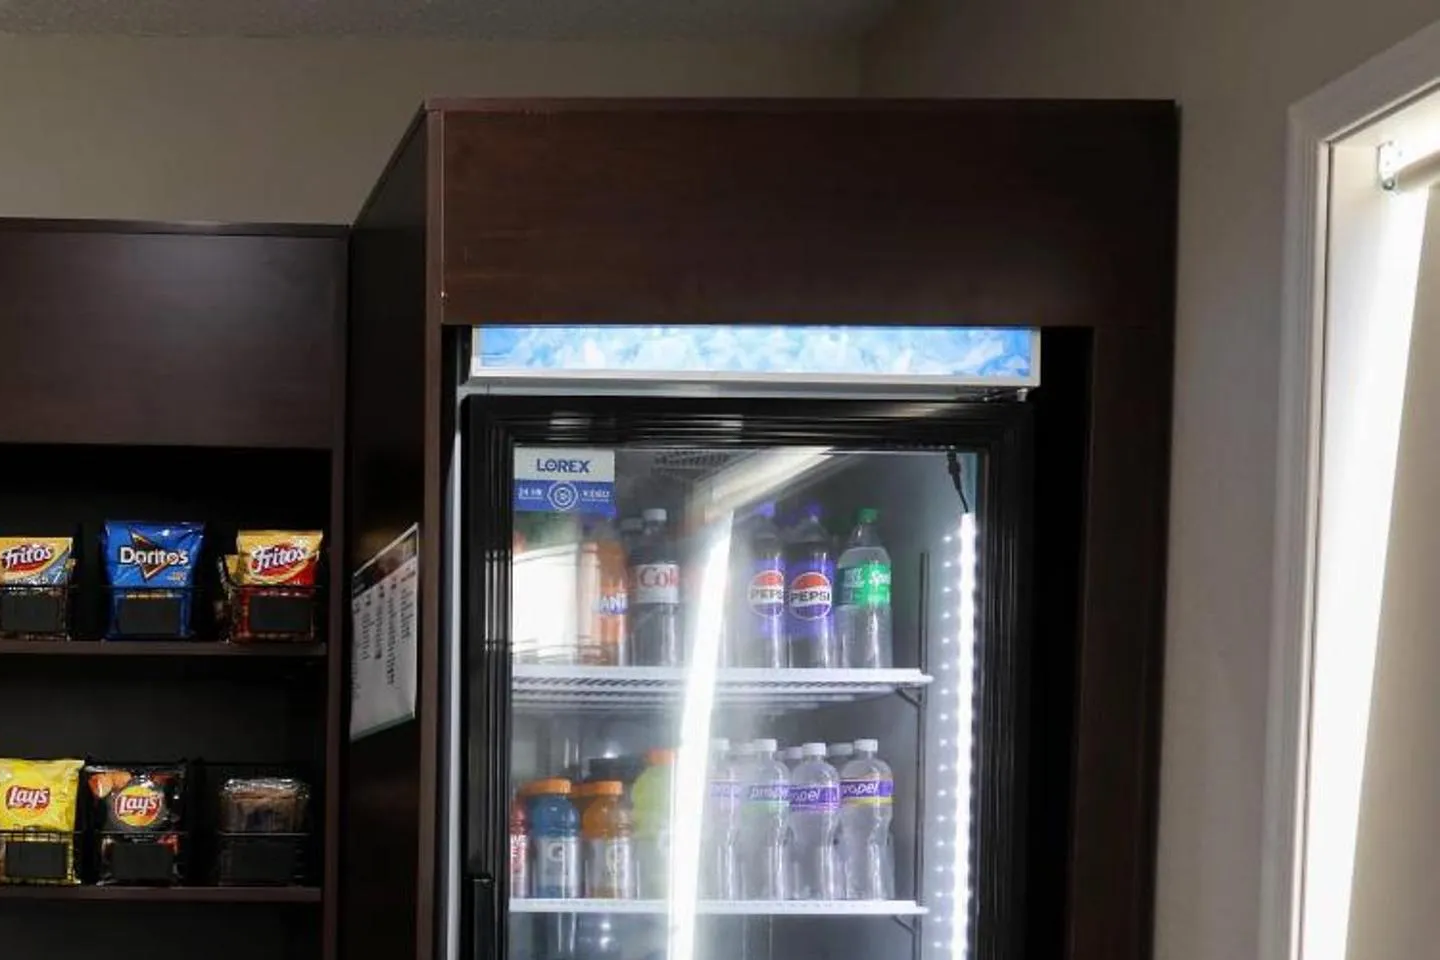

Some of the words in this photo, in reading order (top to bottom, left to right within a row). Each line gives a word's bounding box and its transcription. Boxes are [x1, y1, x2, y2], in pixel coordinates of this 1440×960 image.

[536, 458, 591, 474] LOREX
[1, 546, 52, 569] Fritos
[120, 546, 189, 565] Doritos
[251, 543, 309, 572] Fritos
[8, 785, 49, 809] Lay's
[118, 792, 159, 815] Lay's
